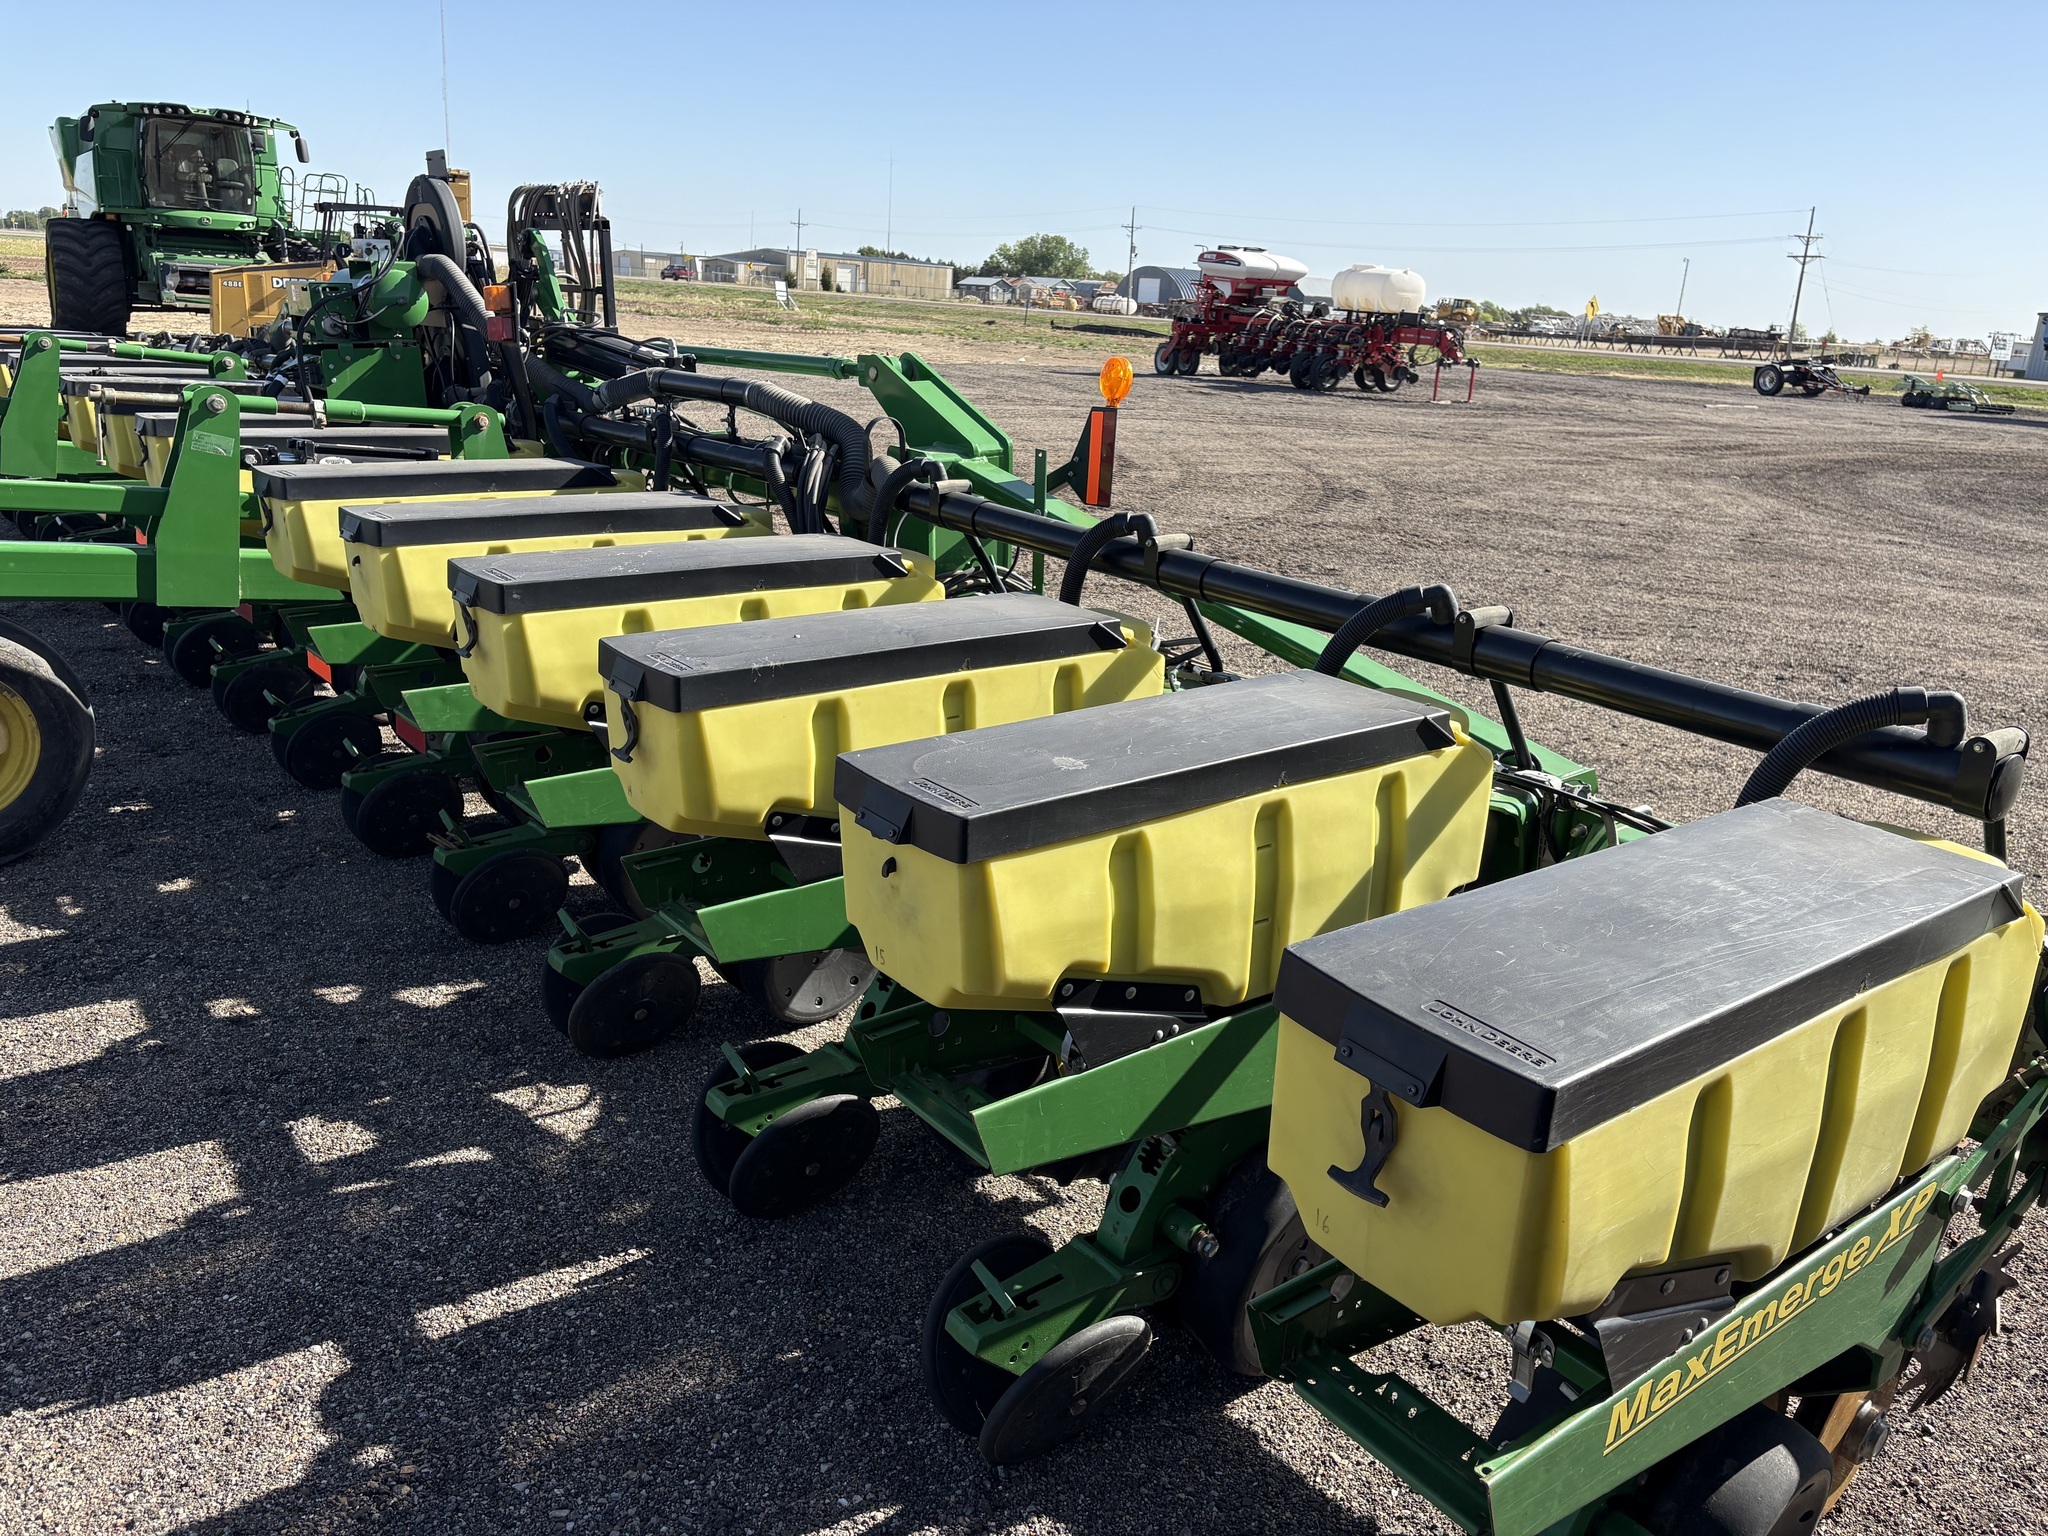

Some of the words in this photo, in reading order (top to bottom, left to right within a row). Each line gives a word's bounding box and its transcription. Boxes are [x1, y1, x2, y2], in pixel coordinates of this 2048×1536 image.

[223, 280, 242, 288] 488E
[875, 945, 885, 965] 15
[1428, 1005, 1483, 1034] JOHN
[1480, 1031, 1549, 1068] DEERE
[1315, 1208, 1330, 1234] 16
[1604, 1235, 1873, 1448] MaxEmerge
[1863, 1181, 1938, 1268] XP
